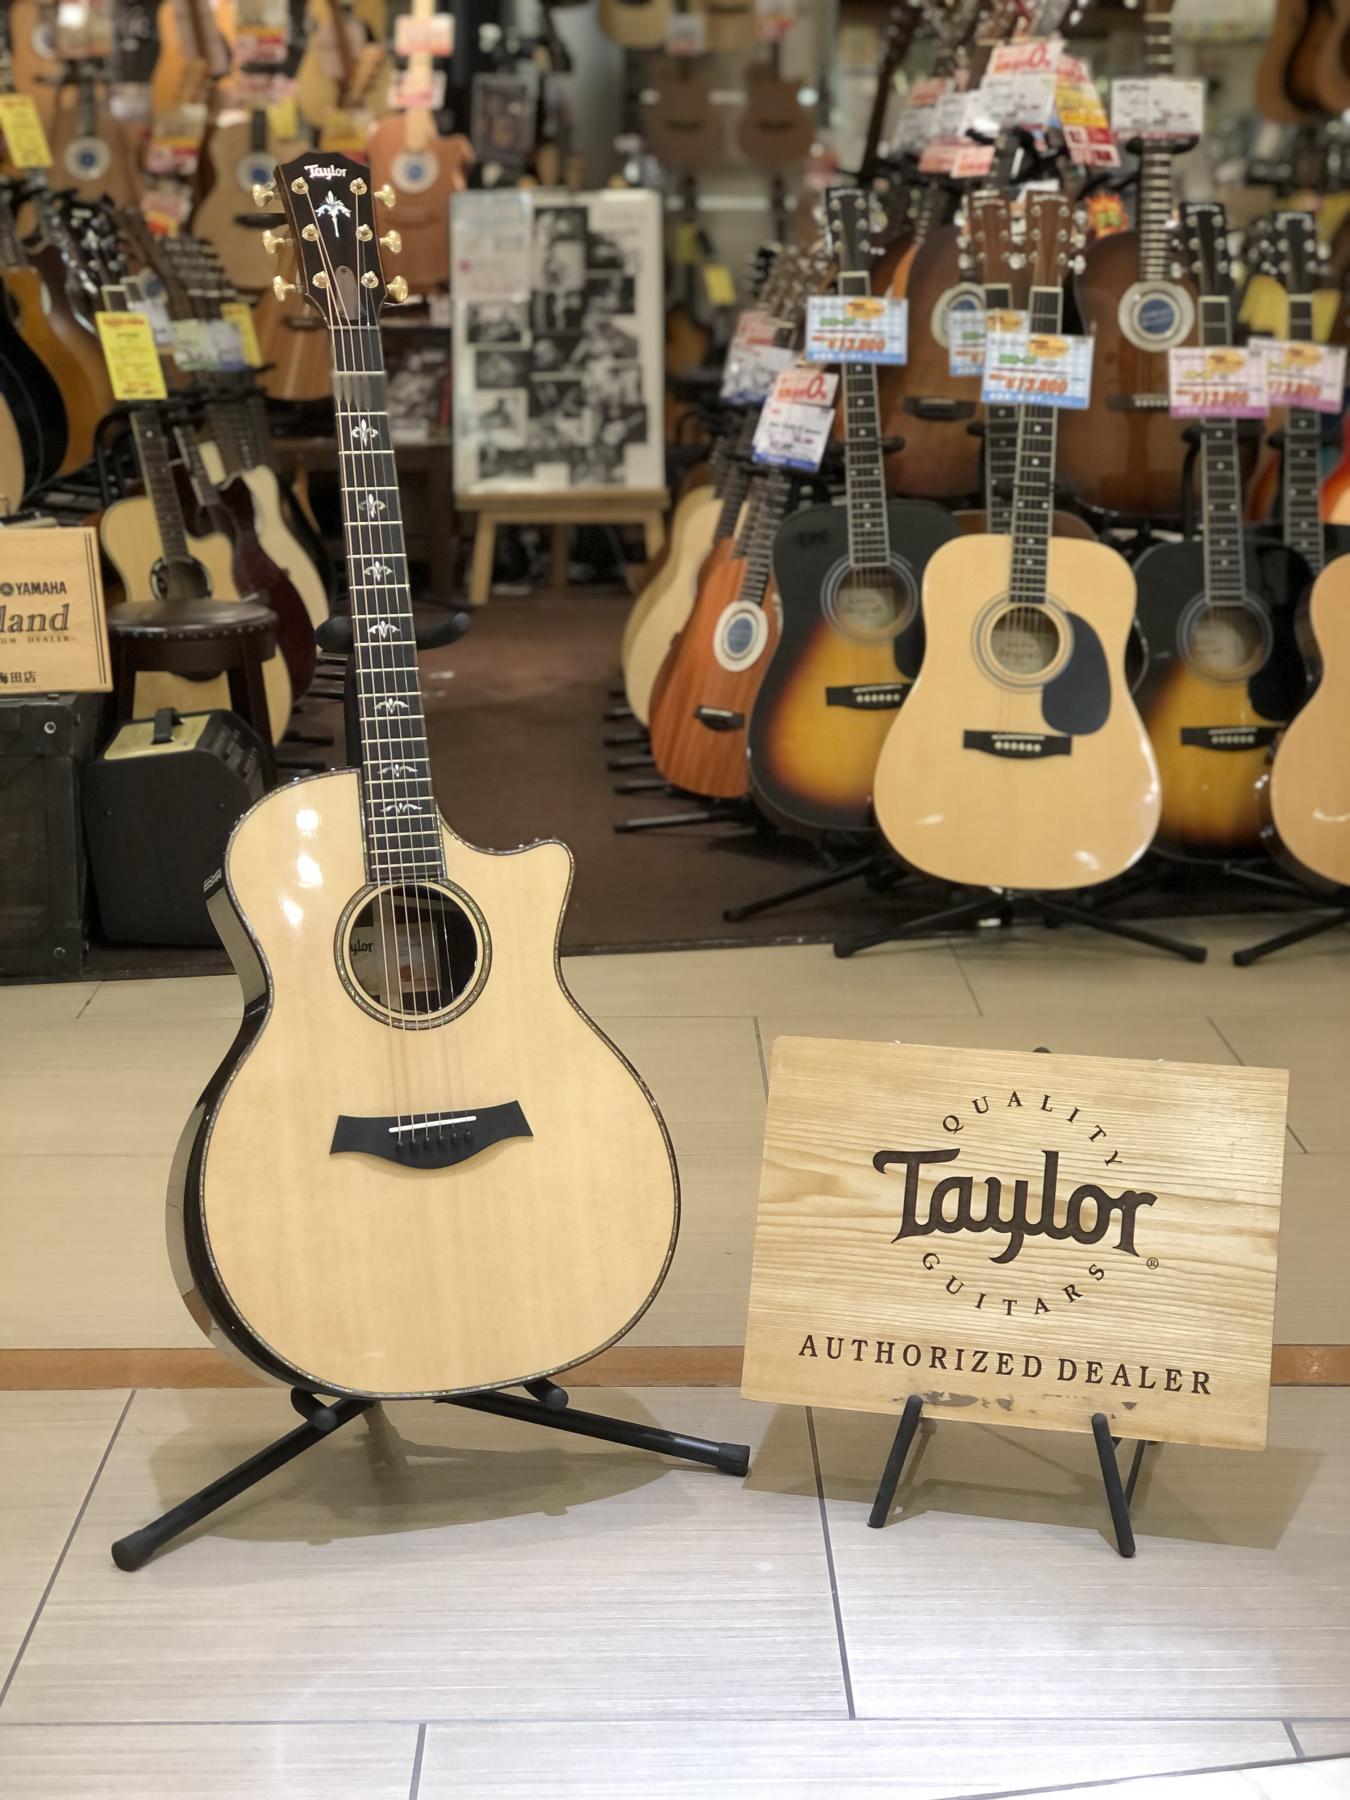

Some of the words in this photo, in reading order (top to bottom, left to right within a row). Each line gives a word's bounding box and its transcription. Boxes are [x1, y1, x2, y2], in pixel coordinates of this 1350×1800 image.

[304, 164, 348, 180] Taylor
[16, 581, 68, 596] YAMAHA
[0, 602, 70, 633] land
[28, 635, 70, 644] DEALER
[942, 1090, 1123, 1167] QUALITY
[872, 1147, 1159, 1264] Taylor
[922, 1252, 1105, 1317] GUITARS
[798, 1334, 1043, 1378] AUTHORIZED
[1057, 1357, 1212, 1395] DEALER
